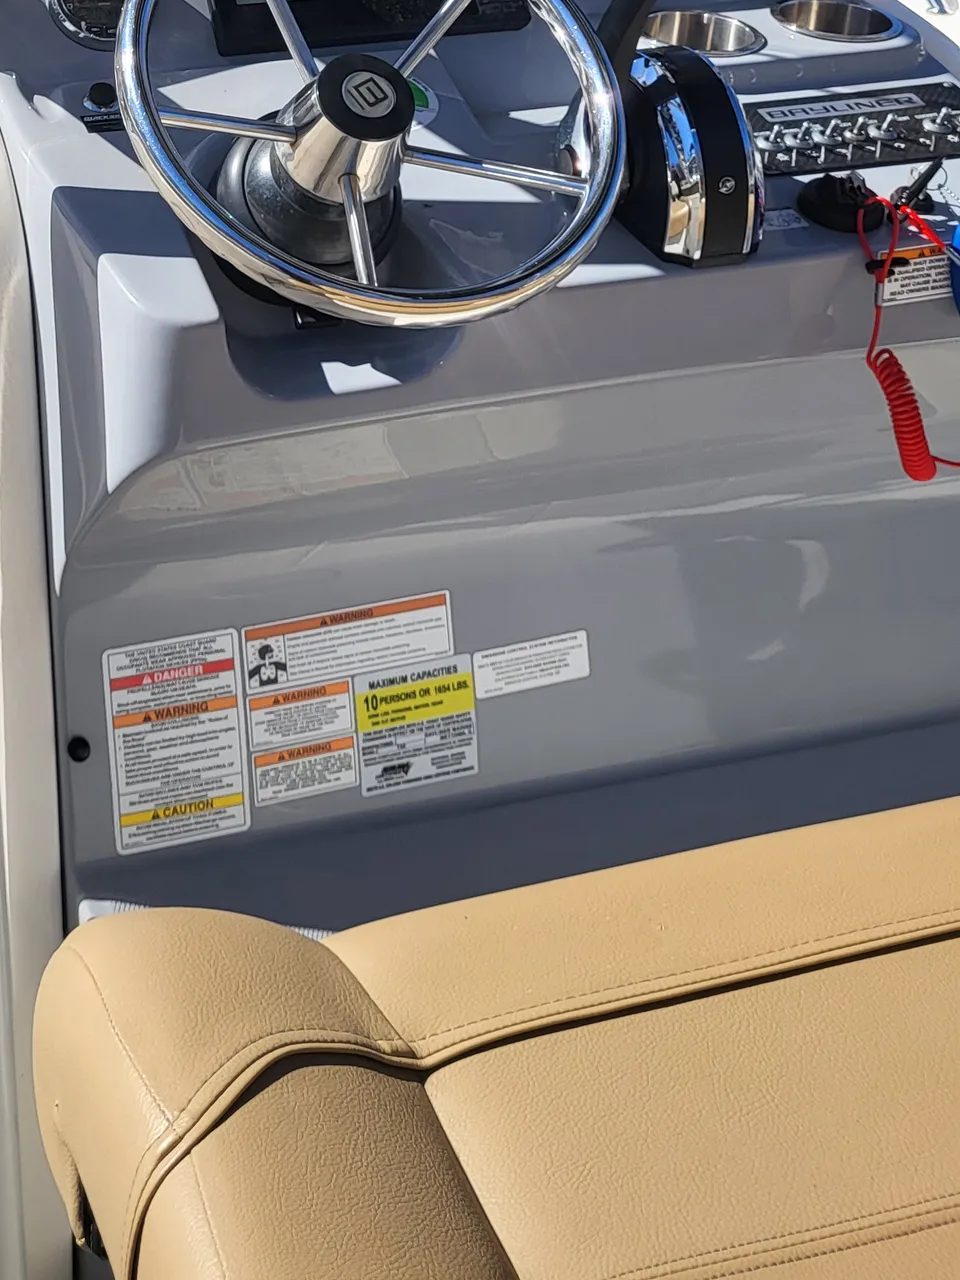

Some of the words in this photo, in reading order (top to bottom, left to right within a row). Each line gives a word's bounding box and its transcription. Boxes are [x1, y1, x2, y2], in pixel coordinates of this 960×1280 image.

[766, 97, 917, 120] BAYLINER
[329, 608, 374, 625] WARNING
[154, 665, 203, 682] DANGER
[368, 674, 408, 690] MAXIMUM
[410, 664, 458, 681] CAPACITIES
[282, 686, 327, 701] WARNING
[364, 694, 378, 712] 10
[379, 689, 417, 705] PERSONS
[418, 687, 431, 698] OR
[452, 679, 470, 693] LBS.
[154, 701, 208, 719] WARNING
[286, 742, 332, 757] WARNING
[162, 798, 214, 818] CAUTION
